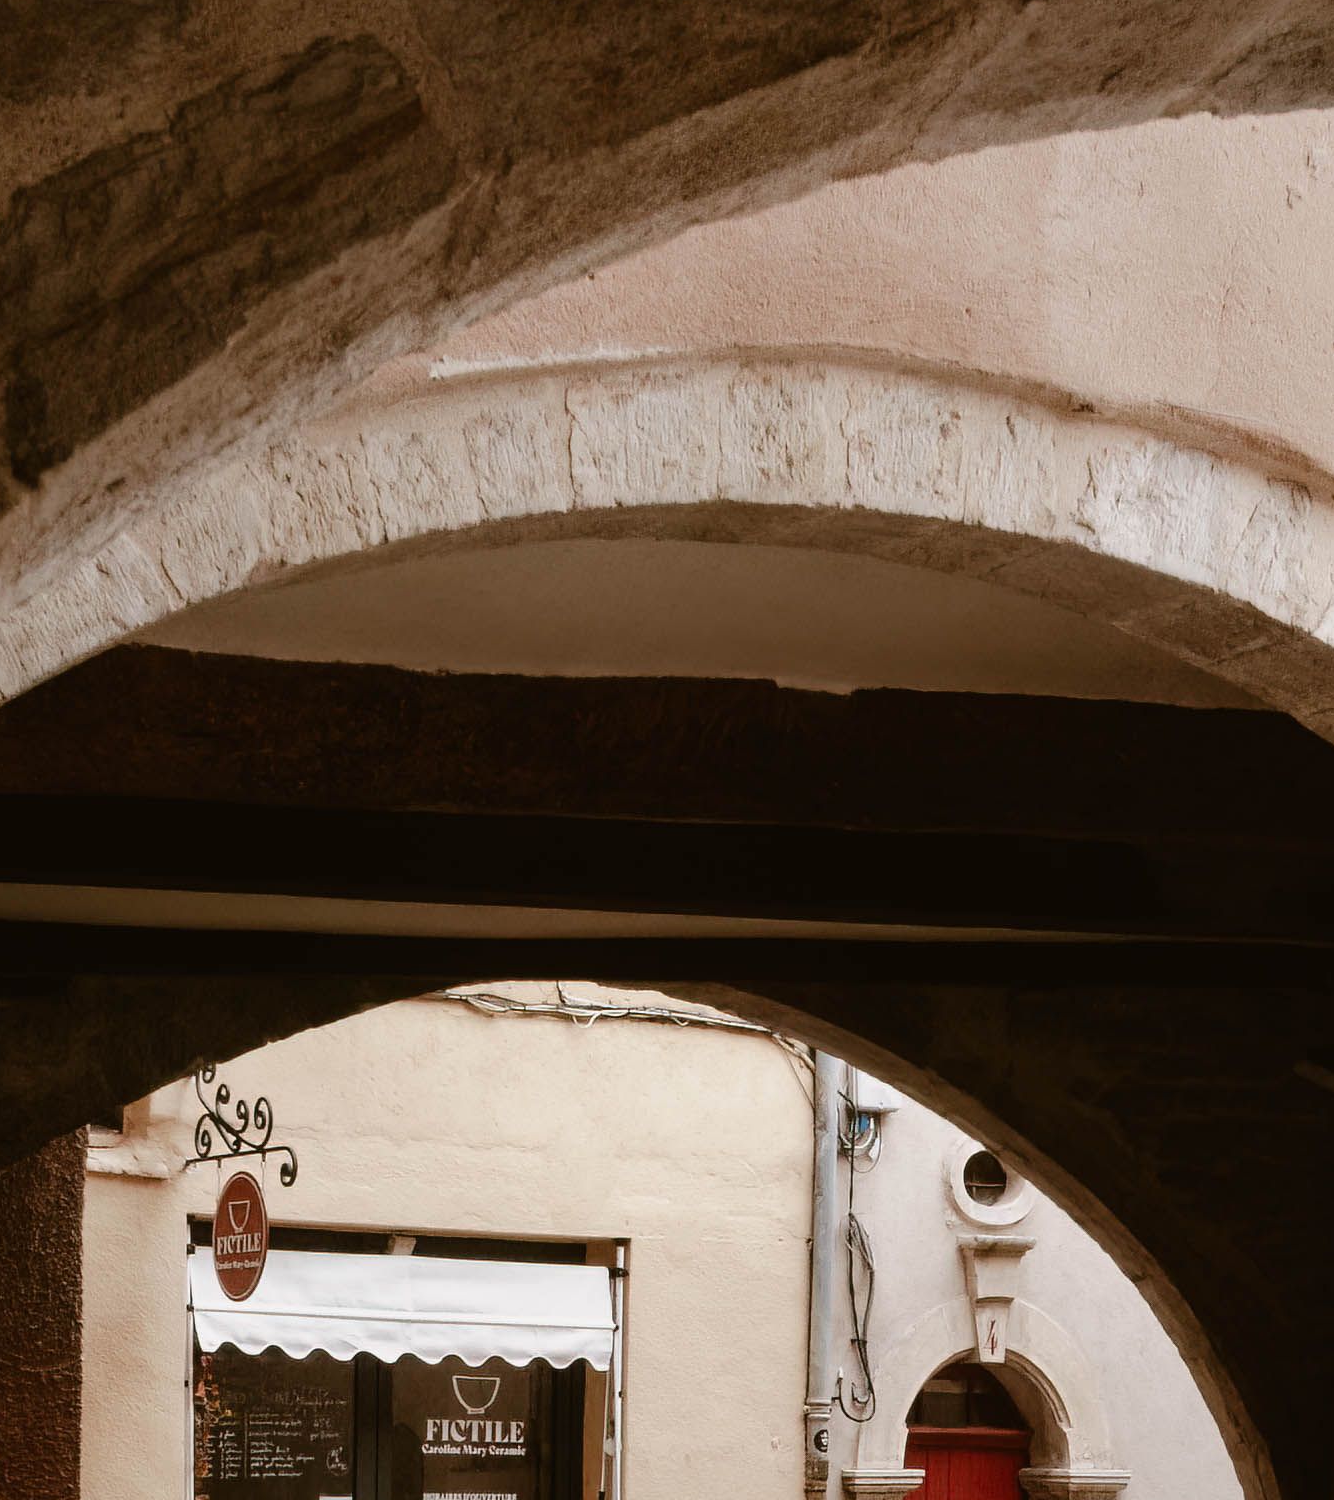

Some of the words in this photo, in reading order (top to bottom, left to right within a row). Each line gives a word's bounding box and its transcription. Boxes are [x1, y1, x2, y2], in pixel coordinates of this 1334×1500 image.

[216, 1233, 262, 1256] FICTILE
[983, 1319, 998, 1355] 4
[426, 1419, 525, 1443] FICTILE
[422, 1444, 461, 1455] Caroline
[462, 1444, 487, 1457] Mary
[488, 1444, 526, 1456] Ceramic
